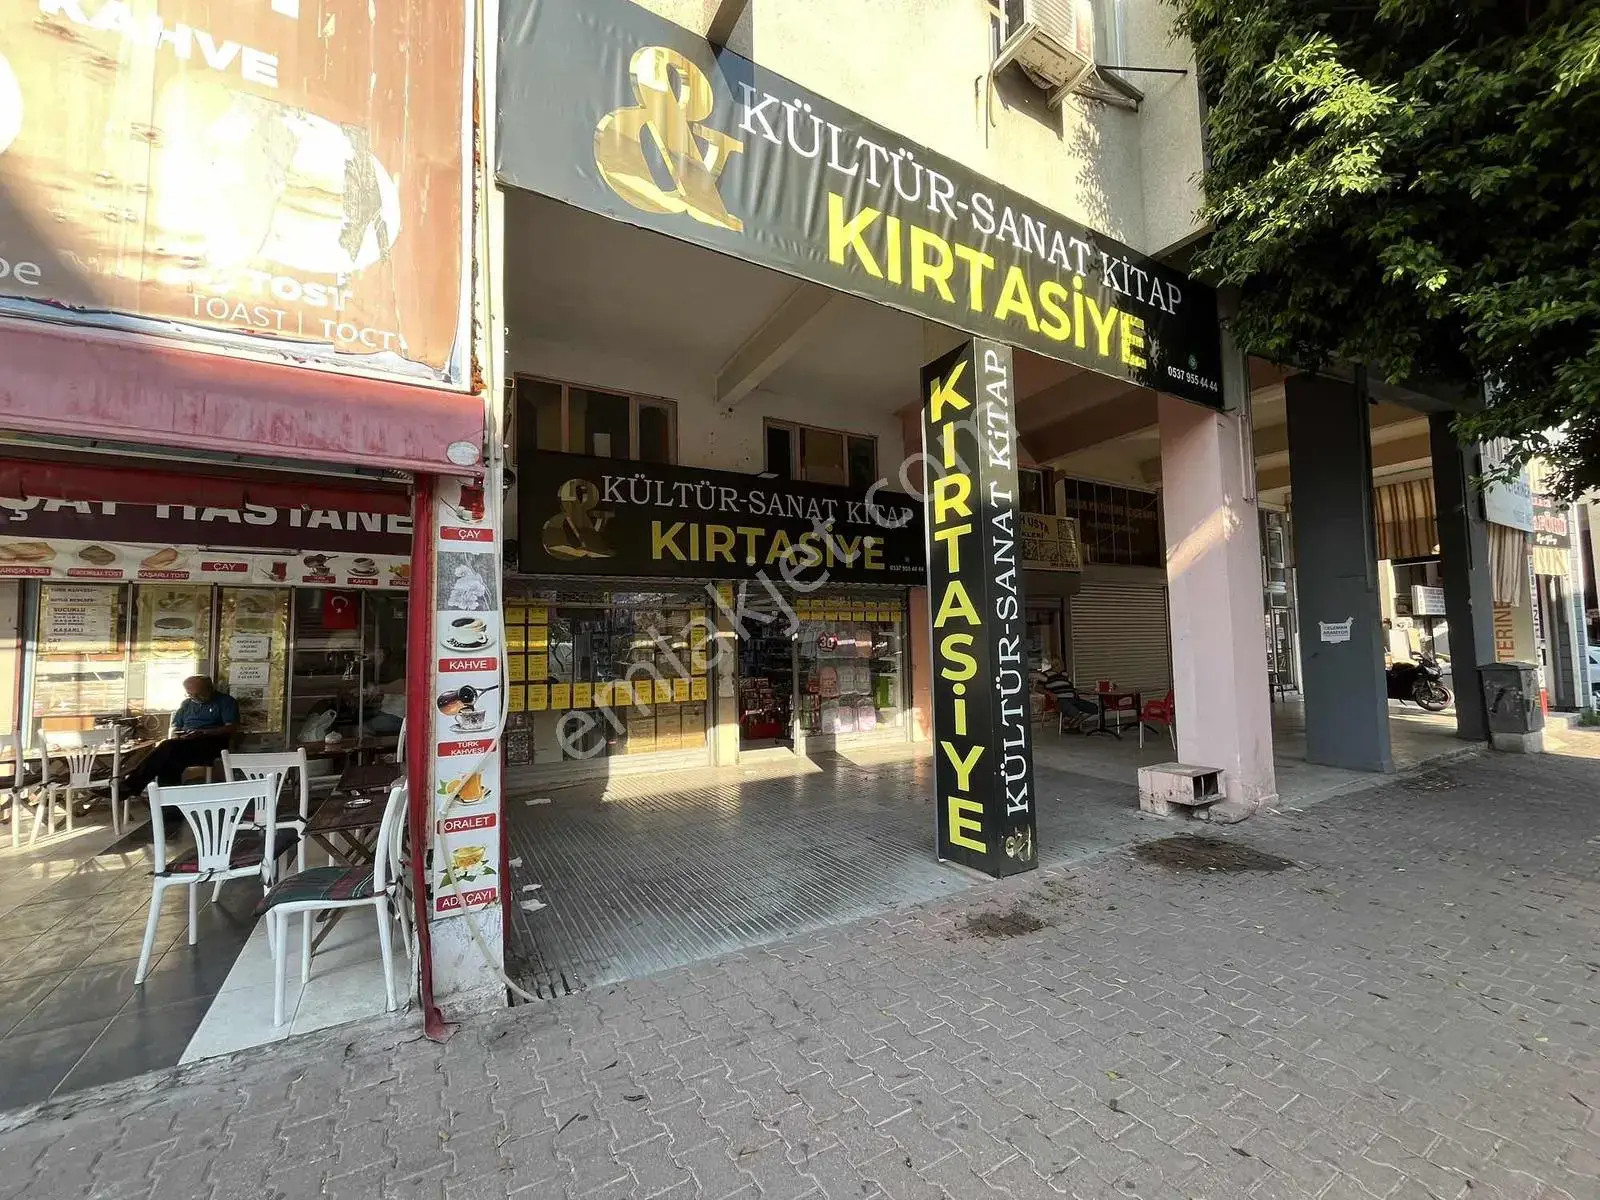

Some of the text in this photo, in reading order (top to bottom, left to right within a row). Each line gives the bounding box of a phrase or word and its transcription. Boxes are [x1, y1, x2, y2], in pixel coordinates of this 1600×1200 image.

[737, 80, 1183, 317] KÜLTÜR-SANAT KİTAP
[827, 191, 1149, 370] KIRTASİYE
[187, 294, 288, 330] TOAST
[1167, 366, 1218, 392] 0537 955 44 44
[601, 473, 914, 529] KÜLTÜR-SANAT KİTAP
[458, 528, 481, 540] ÇAY
[651, 520, 885, 571] KIRTASİYE
[213, 562, 236, 572] ÇAY
[984, 348, 1029, 817] KÜLTÜR-SANAT KİTAP
[930, 360, 987, 854] KIRTASİYE
[449, 660, 488, 672] KAHVE
[451, 746, 485, 756] KAHVESİ
[457, 740, 479, 748] TÜRK
[444, 815, 490, 831] ORALET
